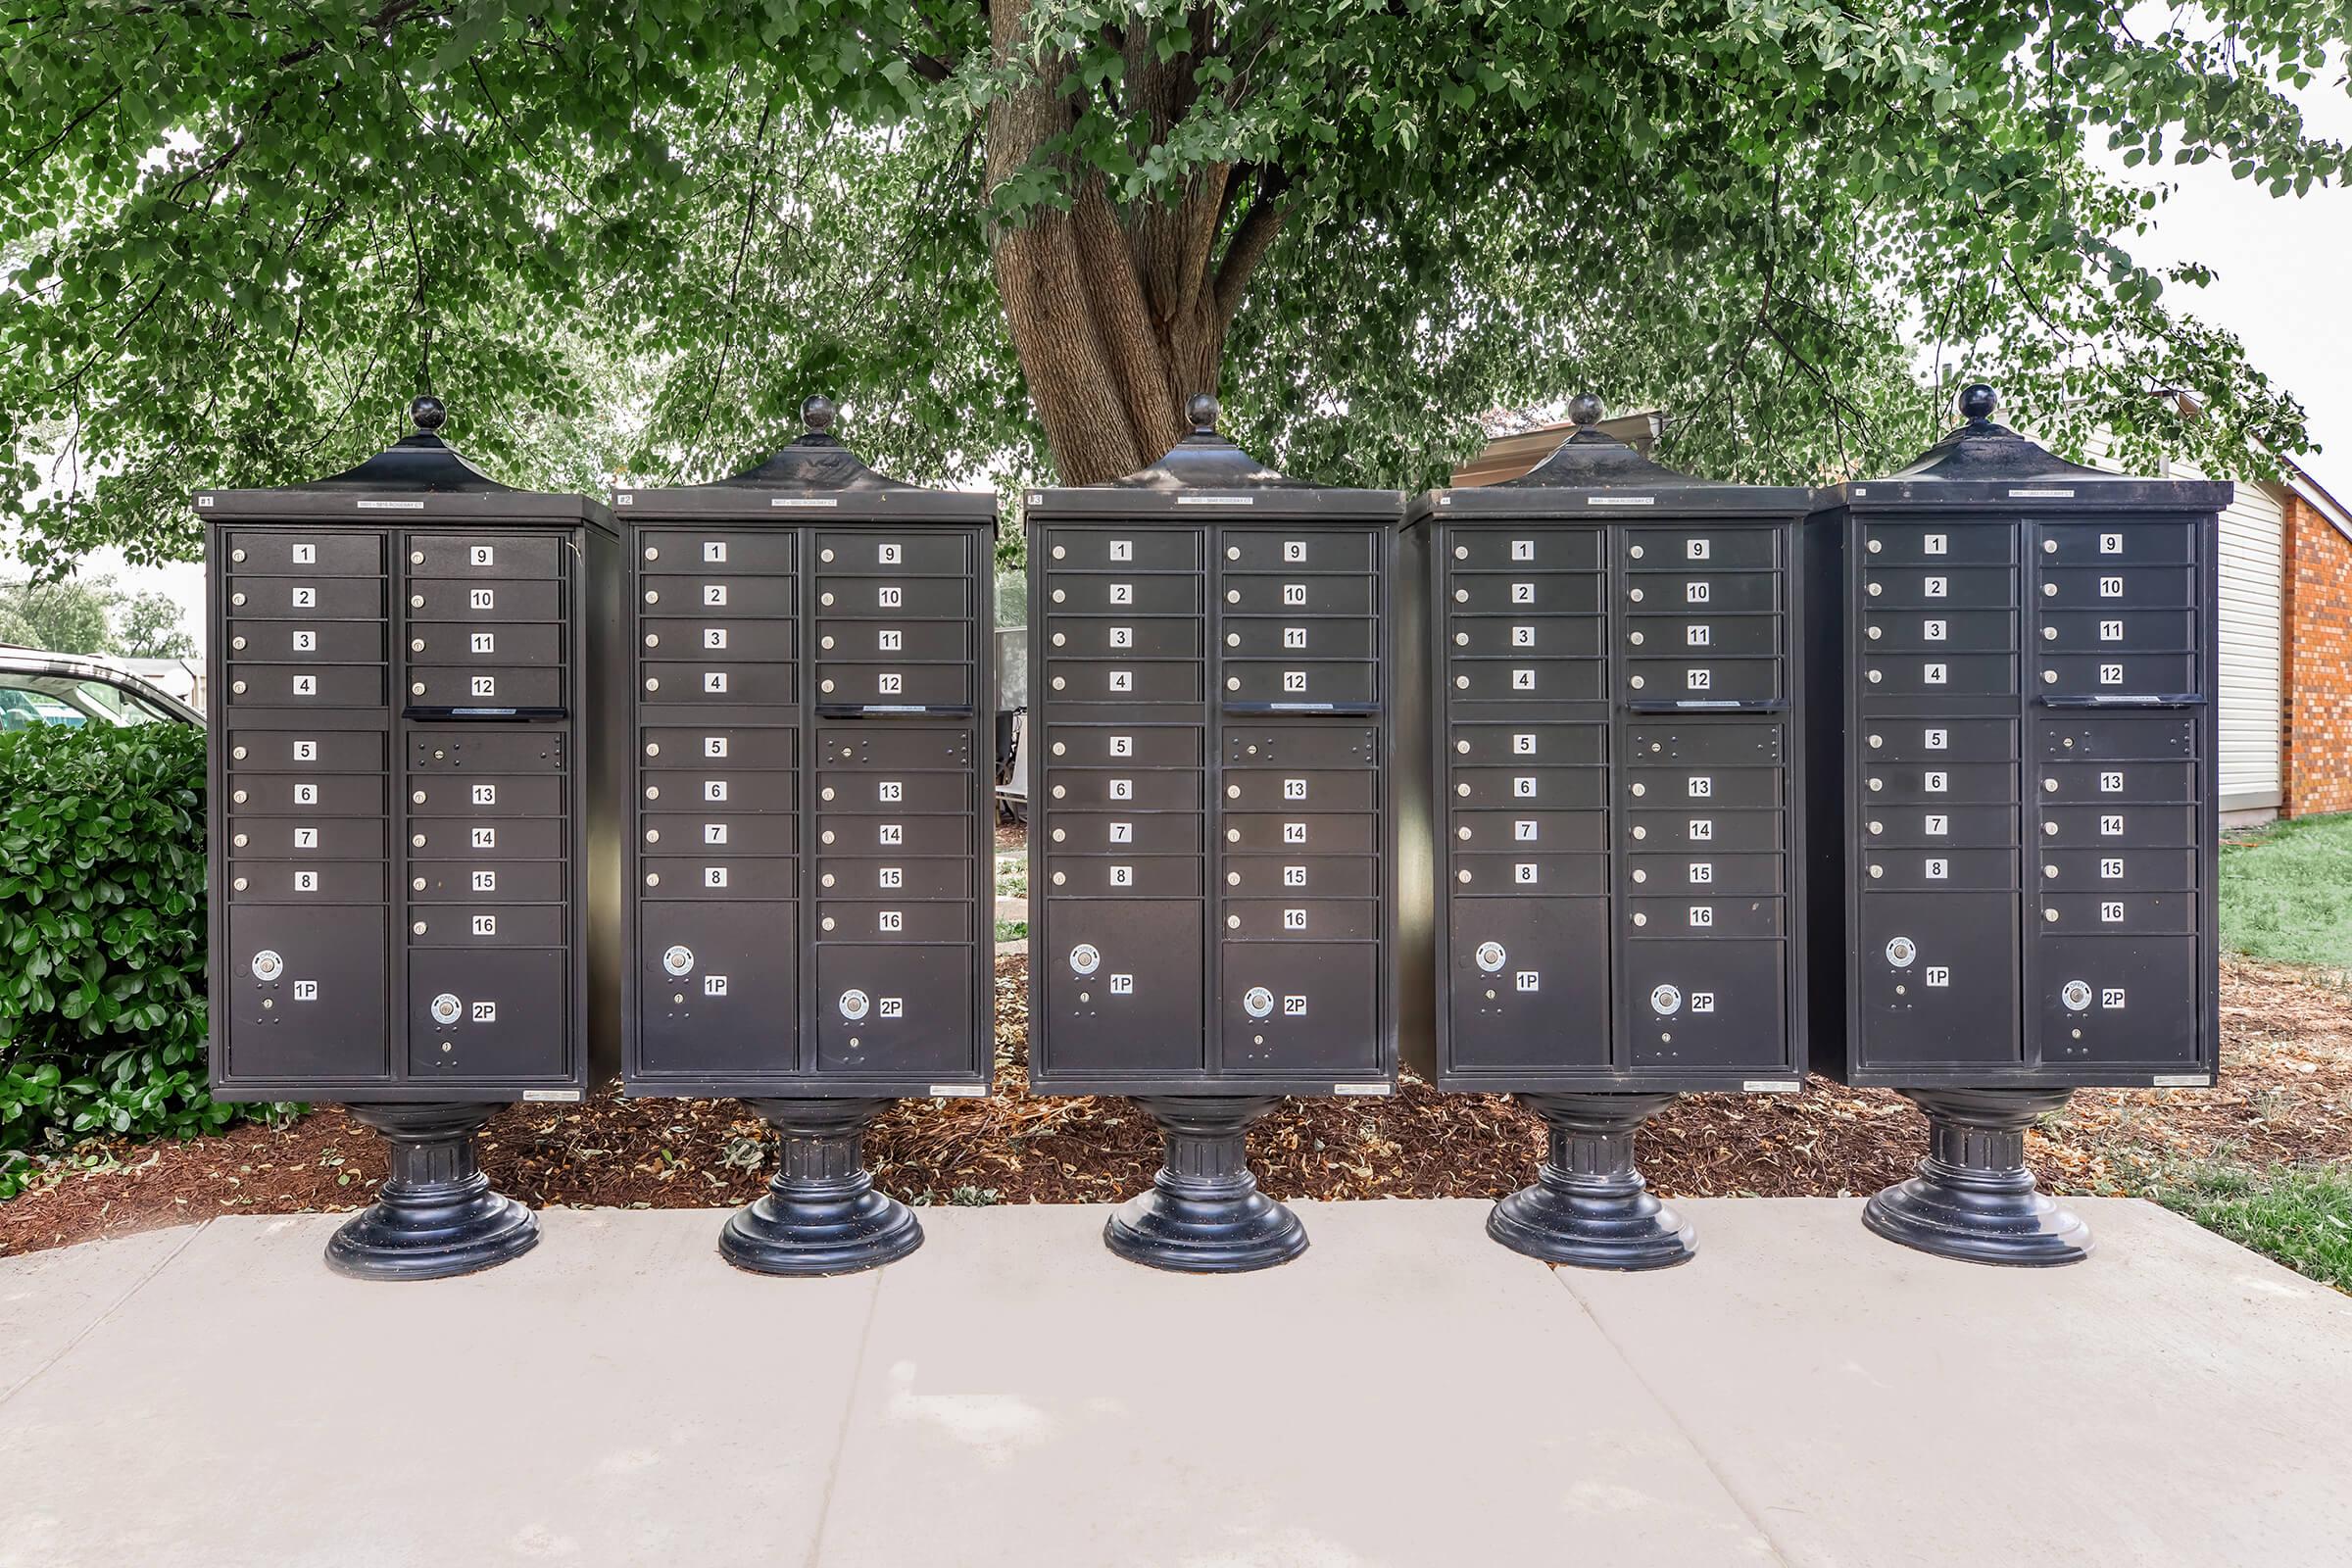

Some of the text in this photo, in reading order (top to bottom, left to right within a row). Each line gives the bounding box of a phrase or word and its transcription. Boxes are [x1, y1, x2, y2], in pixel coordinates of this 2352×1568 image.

[1518, 543, 1528, 558] 1
[1693, 542, 1703, 557] 9
[1931, 537, 1940, 552] 1
[2106, 536, 2116, 551] 9
[300, 547, 309, 561] 1
[477, 549, 487, 564] 9
[710, 545, 719, 559] 1
[885, 547, 895, 562] 9
[1116, 544, 1125, 558] 1
[1291, 545, 1299, 559] 9
[1519, 586, 1529, 600] 2
[1689, 585, 1707, 599] 10
[1931, 580, 1940, 594] 2
[2102, 579, 2121, 594] 10
[299, 590, 309, 605] 2
[472, 592, 491, 606] 10
[710, 588, 720, 602] 2
[881, 590, 899, 604] 10
[1116, 587, 1126, 601] 2
[1286, 587, 1304, 602] 10
[1519, 629, 1528, 643] 3
[1690, 628, 1706, 643] 11
[1931, 623, 1940, 637] 3
[2103, 623, 2120, 637] 11
[300, 634, 310, 648] 3
[474, 636, 491, 650] 11
[710, 631, 720, 646] 3
[882, 633, 899, 648] 11
[1116, 630, 1126, 645] 3
[1287, 631, 1303, 645] 11
[1519, 673, 1529, 687] 4
[1690, 672, 1708, 686] 12
[1931, 666, 1940, 681] 4
[2102, 667, 2121, 681] 12
[299, 678, 310, 692] 4
[473, 679, 492, 693] 12
[710, 675, 721, 689] 4
[881, 676, 900, 691] 12
[1115, 674, 1126, 688] 4
[1286, 674, 1304, 689] 12
[1520, 737, 1530, 751] 5
[1932, 732, 1941, 746] 5
[301, 744, 310, 758] 5
[711, 740, 721, 754] 5
[1116, 739, 1126, 754] 5
[1520, 780, 1530, 794] 6
[1690, 780, 1709, 794] 13
[1932, 774, 1941, 789] 6
[2102, 775, 2121, 789] 13
[301, 787, 311, 801] 6
[474, 788, 493, 802] 13
[711, 784, 720, 798] 6
[881, 784, 900, 799] 13
[1116, 782, 1126, 797] 6
[1286, 782, 1304, 796] 13
[1521, 823, 1531, 838] 7
[1691, 823, 1710, 837] 14
[1932, 818, 1941, 832] 7
[2103, 818, 2122, 832] 14
[301, 831, 311, 845] 7
[474, 831, 493, 845] 14
[711, 827, 721, 841] 7
[882, 827, 900, 842] 14
[1116, 826, 1126, 840] 7
[1286, 826, 1303, 840] 14
[1522, 866, 1531, 880] 8
[1691, 866, 1710, 881] 15
[1932, 861, 1941, 876] 8
[2103, 861, 2122, 875] 15
[302, 874, 311, 888] 8
[474, 874, 493, 888] 15
[711, 870, 720, 884] 8
[882, 870, 900, 885] 15
[1116, 869, 1126, 883] 8
[1286, 869, 1304, 884] 15
[1692, 909, 1710, 923] 16
[2103, 905, 2122, 918] 16
[474, 918, 493, 932] 16
[881, 914, 900, 928] 16
[1286, 912, 1304, 926] 16
[1112, 977, 1131, 991] 1P
[1518, 974, 1538, 989] 1P
[1928, 970, 1947, 984] 1P
[296, 983, 316, 998] 1P
[706, 979, 725, 993] 1P
[1286, 999, 1305, 1012] 2P
[1693, 996, 1713, 1009] 2P
[2104, 992, 2124, 1005] 2P
[474, 1004, 494, 1019] 2P
[881, 1001, 901, 1014] 2P
